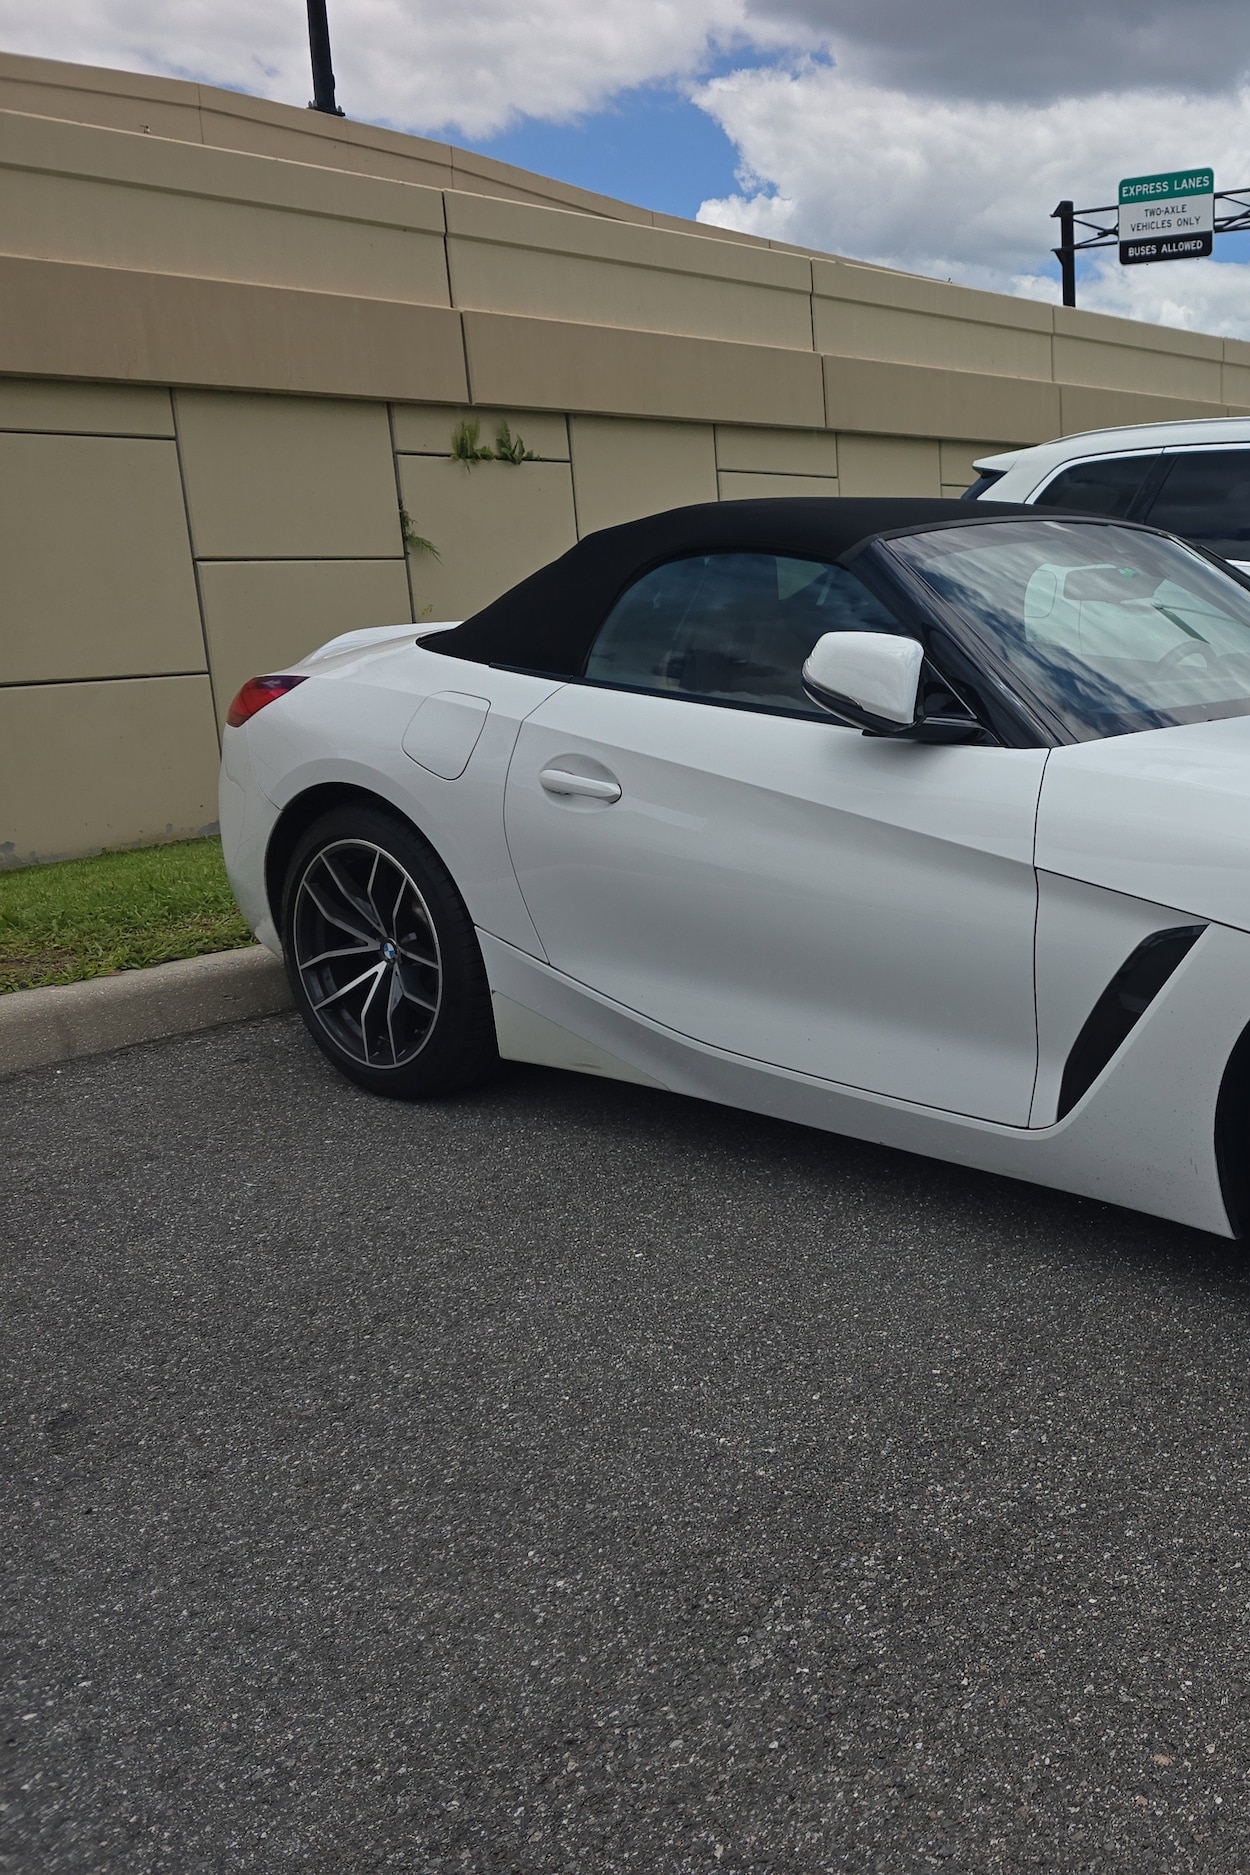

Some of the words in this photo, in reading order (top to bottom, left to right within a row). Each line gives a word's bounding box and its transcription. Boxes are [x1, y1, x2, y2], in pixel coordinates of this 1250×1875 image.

[1122, 181, 1169, 197] EXPRESS
[1174, 175, 1210, 191] LANES
[1144, 204, 1188, 218] TWO-AXLE
[1130, 219, 1172, 232] VEHICLES
[1176, 216, 1201, 227] ONLY
[1128, 245, 1157, 257] BUSES
[1161, 240, 1203, 253] ALLOWED
